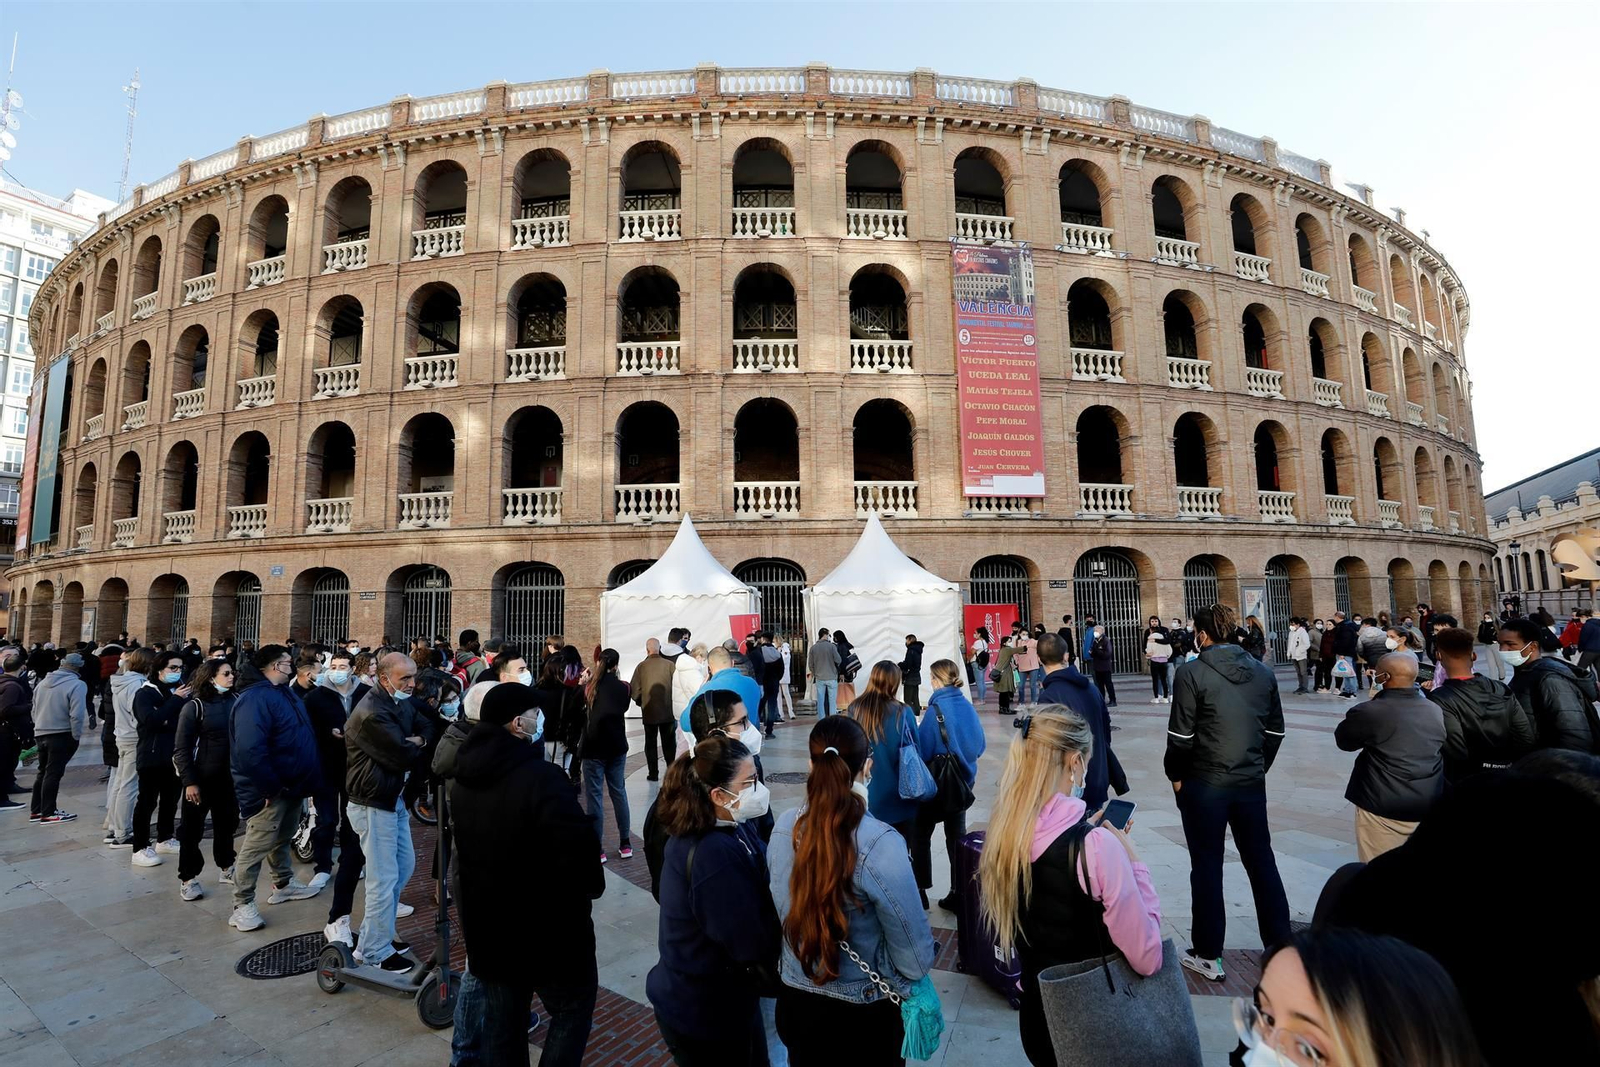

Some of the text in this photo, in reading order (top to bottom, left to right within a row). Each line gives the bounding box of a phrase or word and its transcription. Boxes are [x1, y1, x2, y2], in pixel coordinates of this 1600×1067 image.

[958, 300, 1032, 317] VALENCIA
[962, 332, 968, 341] 5
[962, 356, 1036, 366] VÍCTOR PUERTO
[968, 371, 1030, 380] UCEDA LEAL
[966, 386, 1033, 396] MATÍAS TEJELA
[965, 402, 1035, 411] OCTAVIO CHACÓN
[968, 432, 1035, 441] JOAQUÍN GALDÓS
[973, 448, 1031, 457] JESÚS CHOVER
